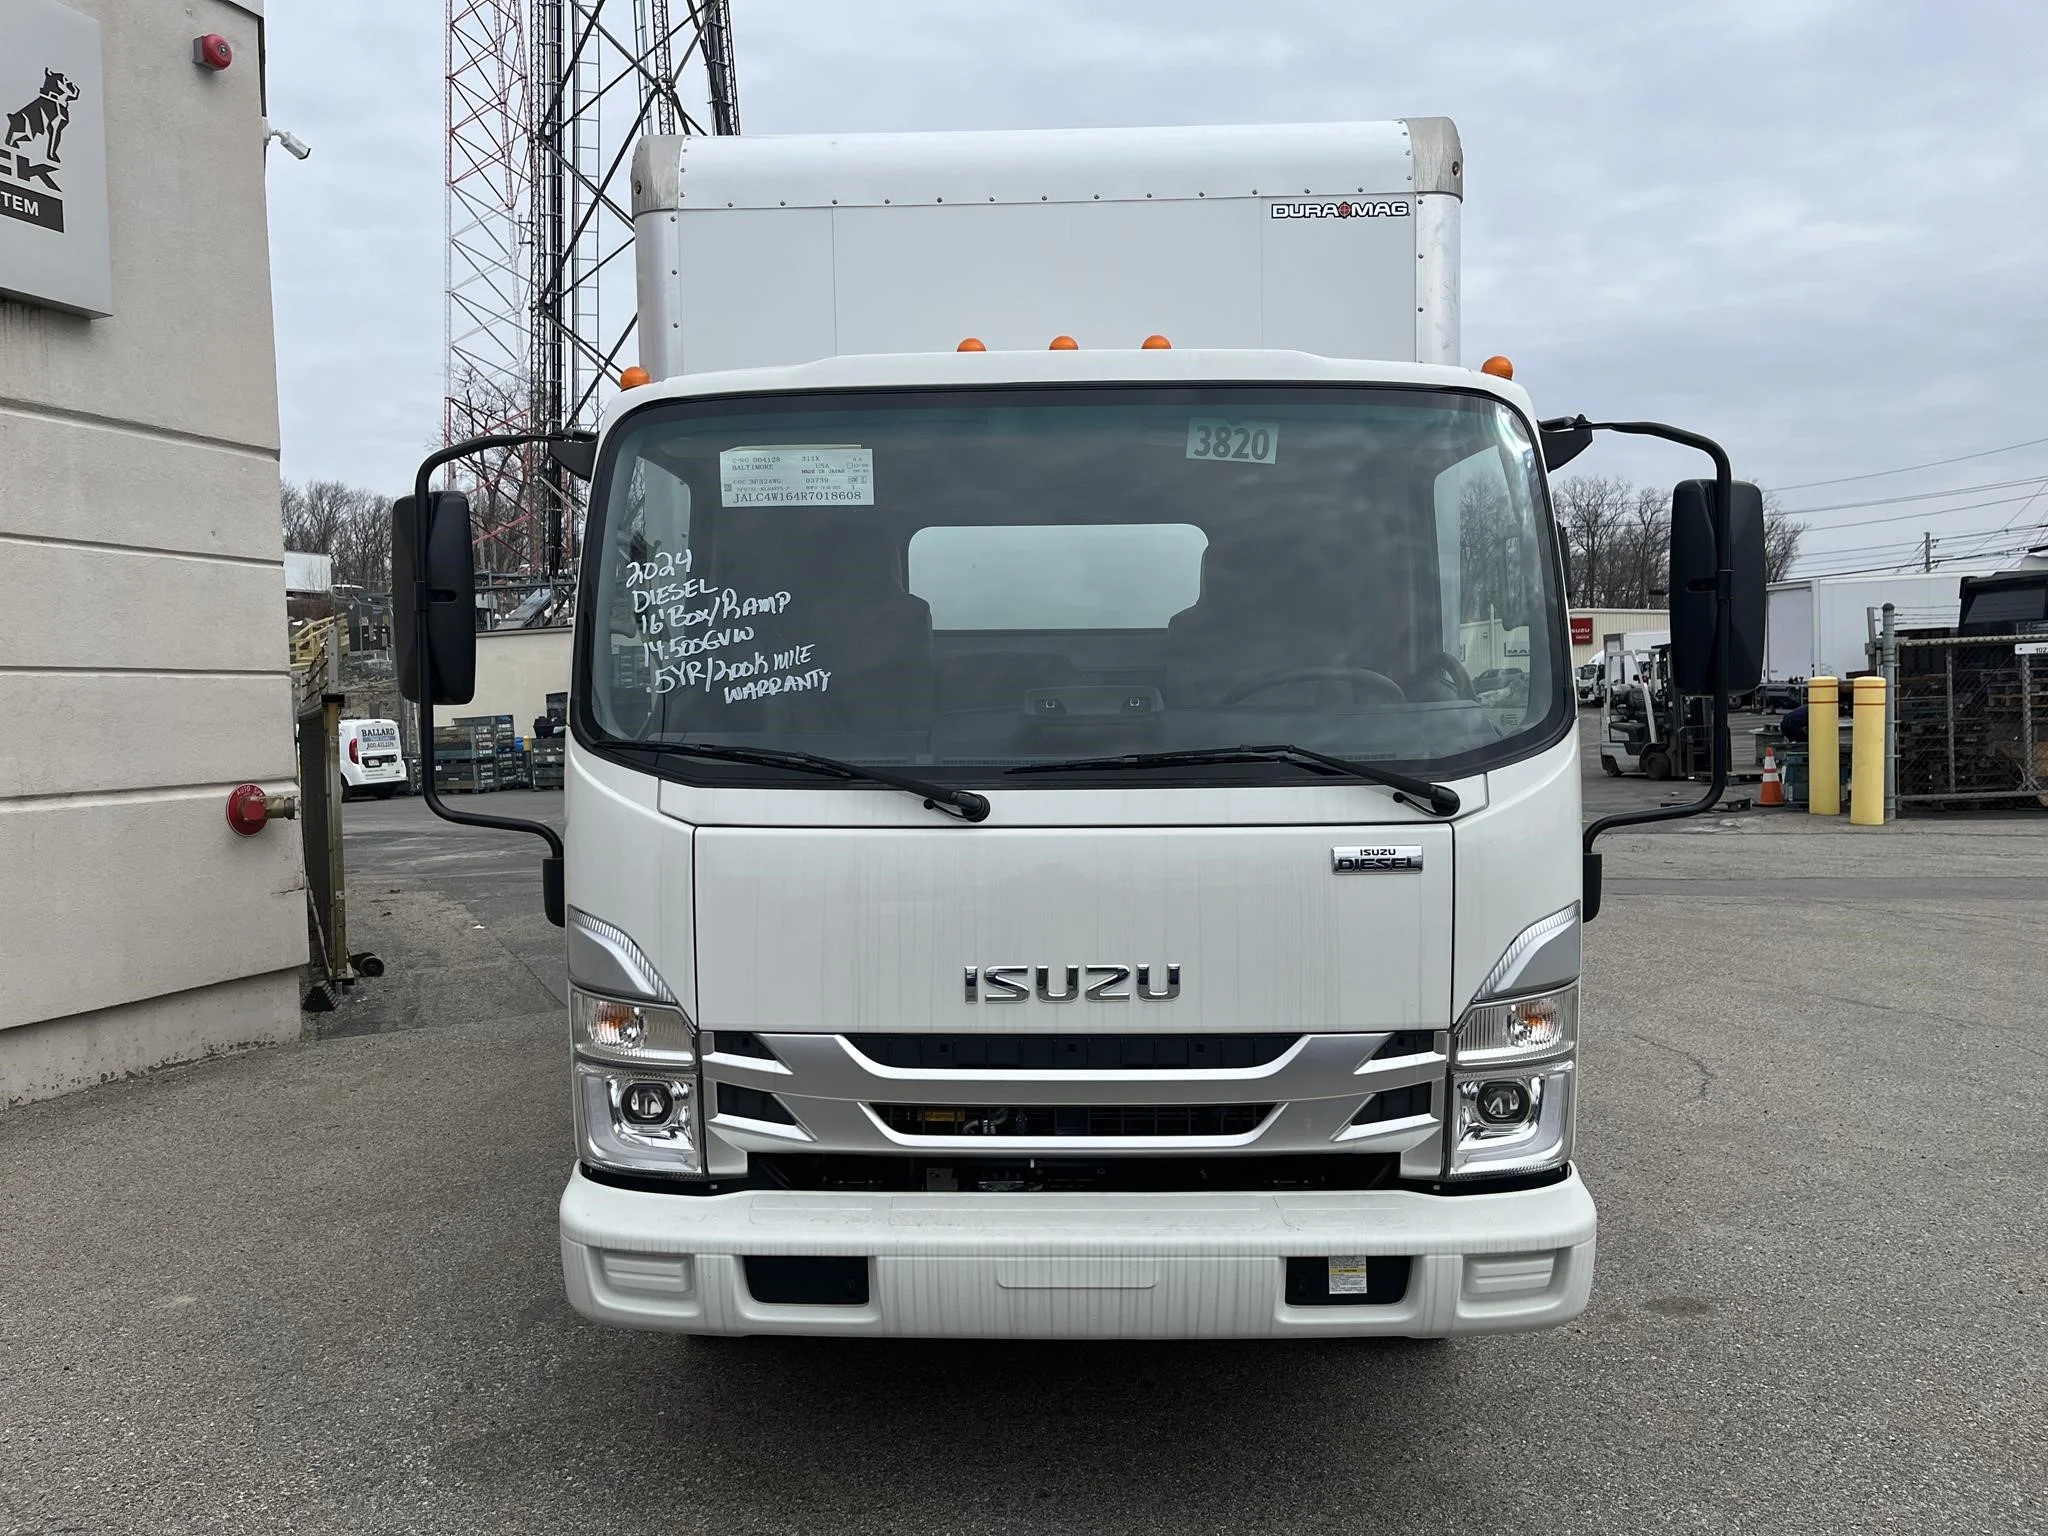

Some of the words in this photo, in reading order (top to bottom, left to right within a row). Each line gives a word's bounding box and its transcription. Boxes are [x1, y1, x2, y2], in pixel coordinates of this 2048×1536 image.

[1193, 425, 1270, 461] 3820
[733, 491, 861, 503] JALC4W164R7018608
[626, 549, 692, 588] 2024
[632, 578, 719, 613] DIESEL
[773, 644, 815, 672] MILE
[724, 668, 831, 704] WARRANTY
[361, 728, 395, 737] BALLARD
[236, 785, 251, 796] AUTO
[1337, 857, 1422, 870] DIESEL
[1360, 848, 1396, 856] ISUZU
[965, 964, 1181, 1003] ISUZU
